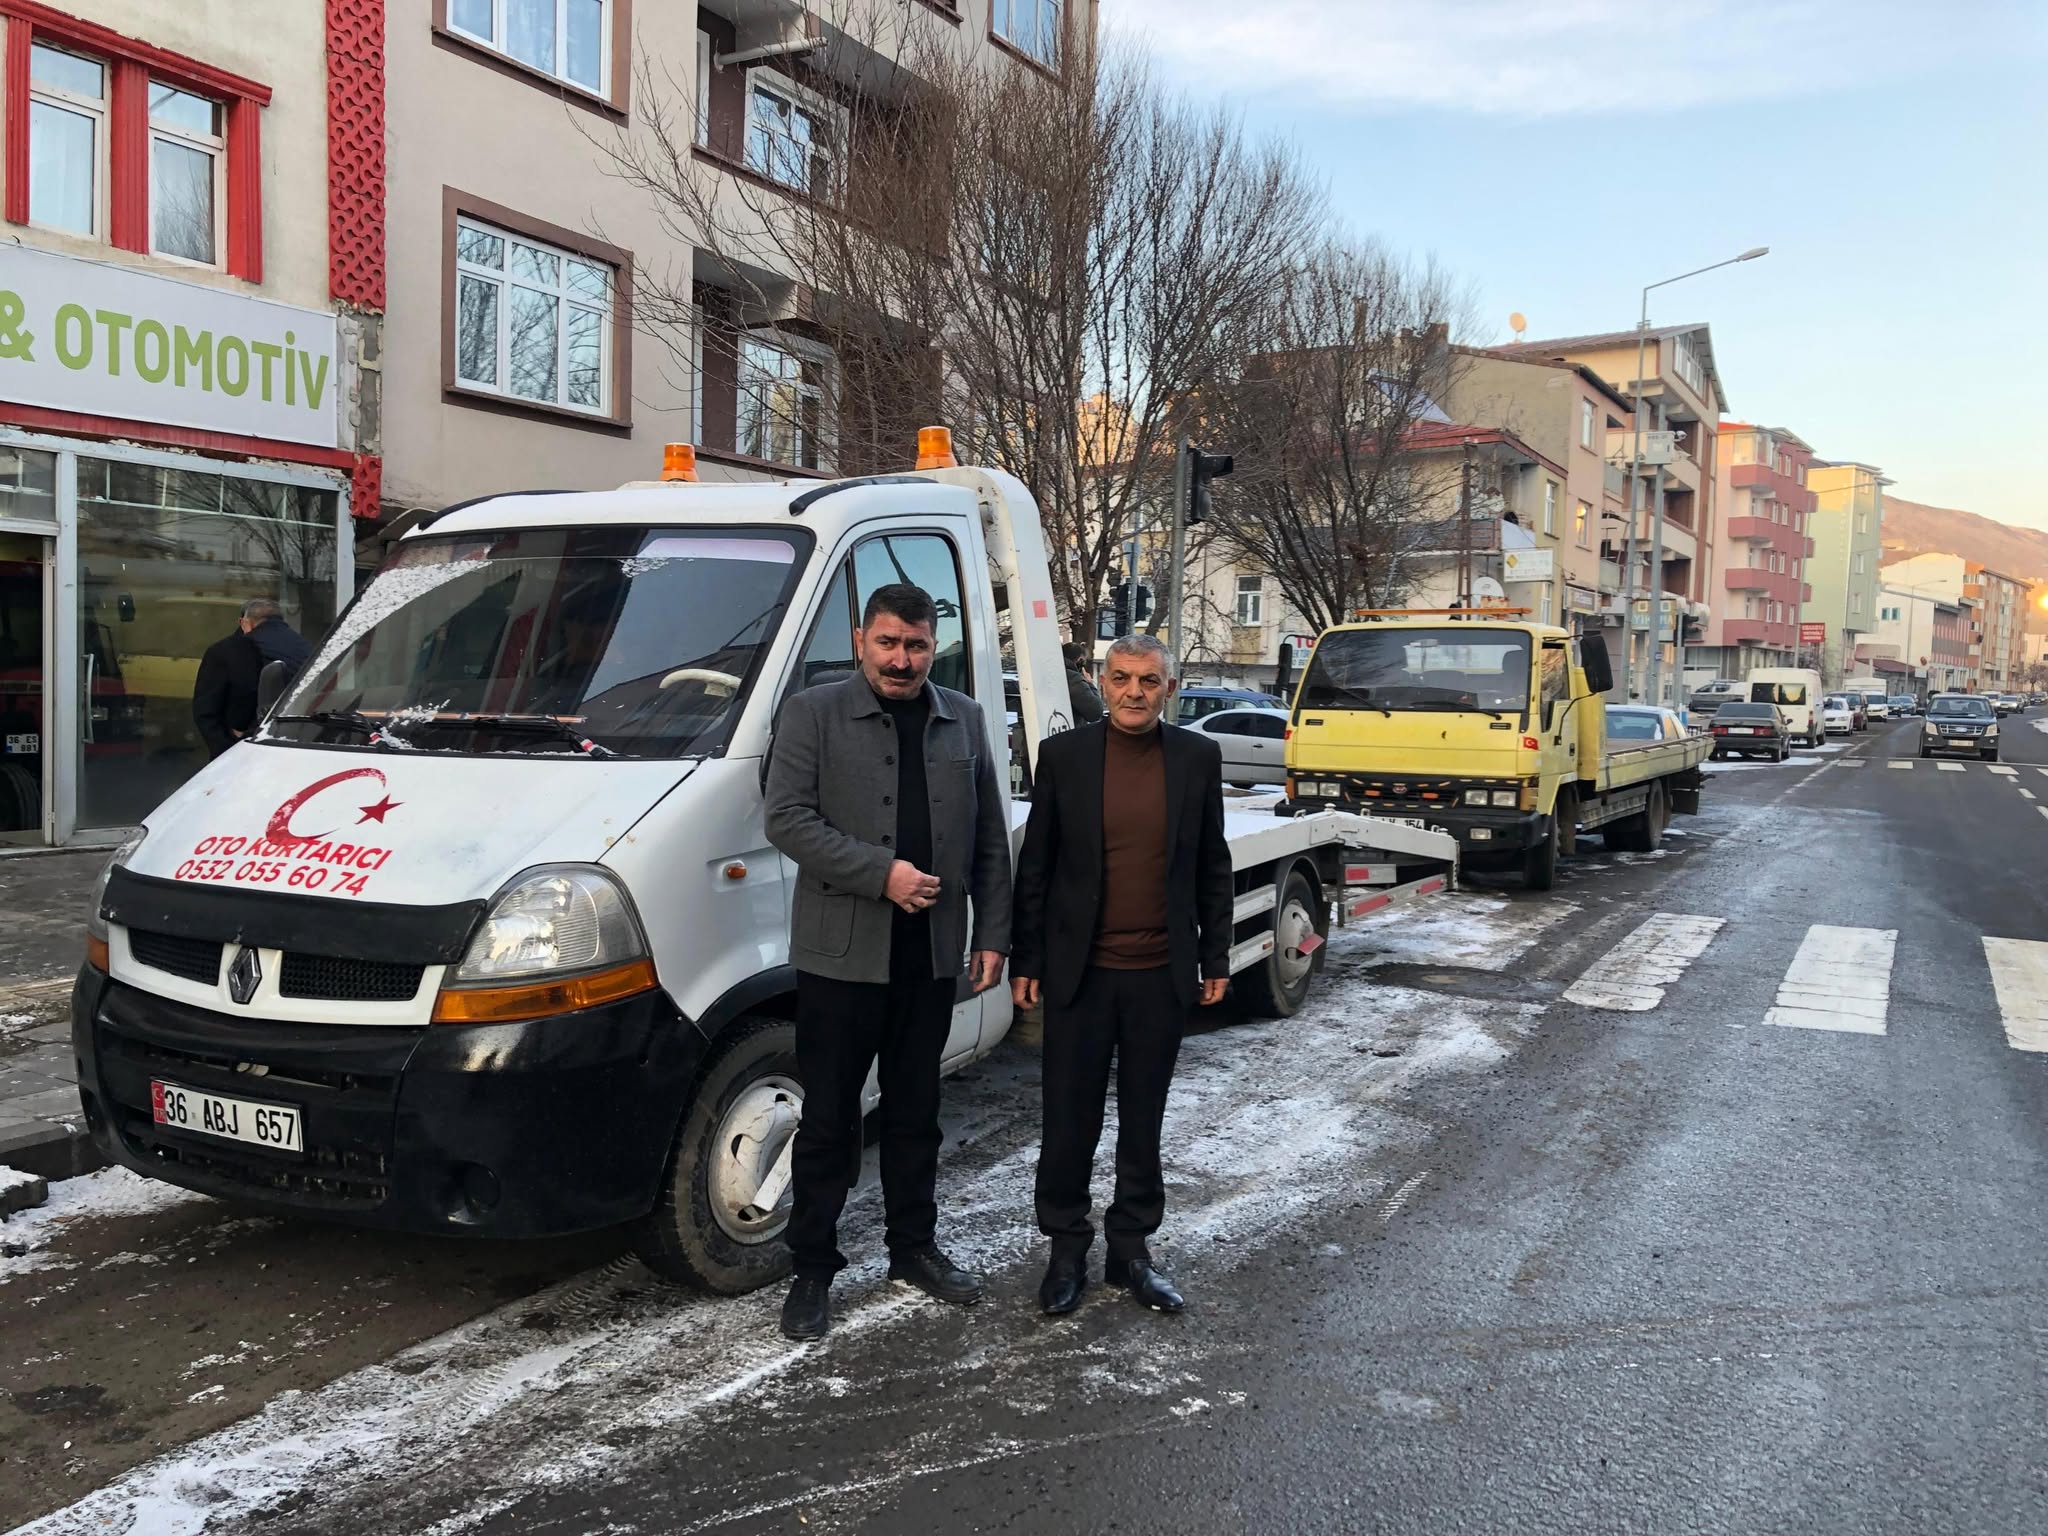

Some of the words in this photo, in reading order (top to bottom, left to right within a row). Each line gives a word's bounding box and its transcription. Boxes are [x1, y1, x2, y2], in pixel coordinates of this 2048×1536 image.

[0, 290, 35, 362] &
[55, 303, 329, 410] OTOMOTİV
[8, 736, 20, 744] 36
[194, 836, 248, 856] OTO
[243, 837, 393, 871] KURTARICI
[174, 859, 234, 880] 0532
[235, 861, 287, 882] 055
[287, 865, 328, 889] 60
[329, 872, 370, 896] 74
[164, 1090, 187, 1125] 36
[203, 1098, 239, 1136] ABJ
[255, 1108, 295, 1145] 657
